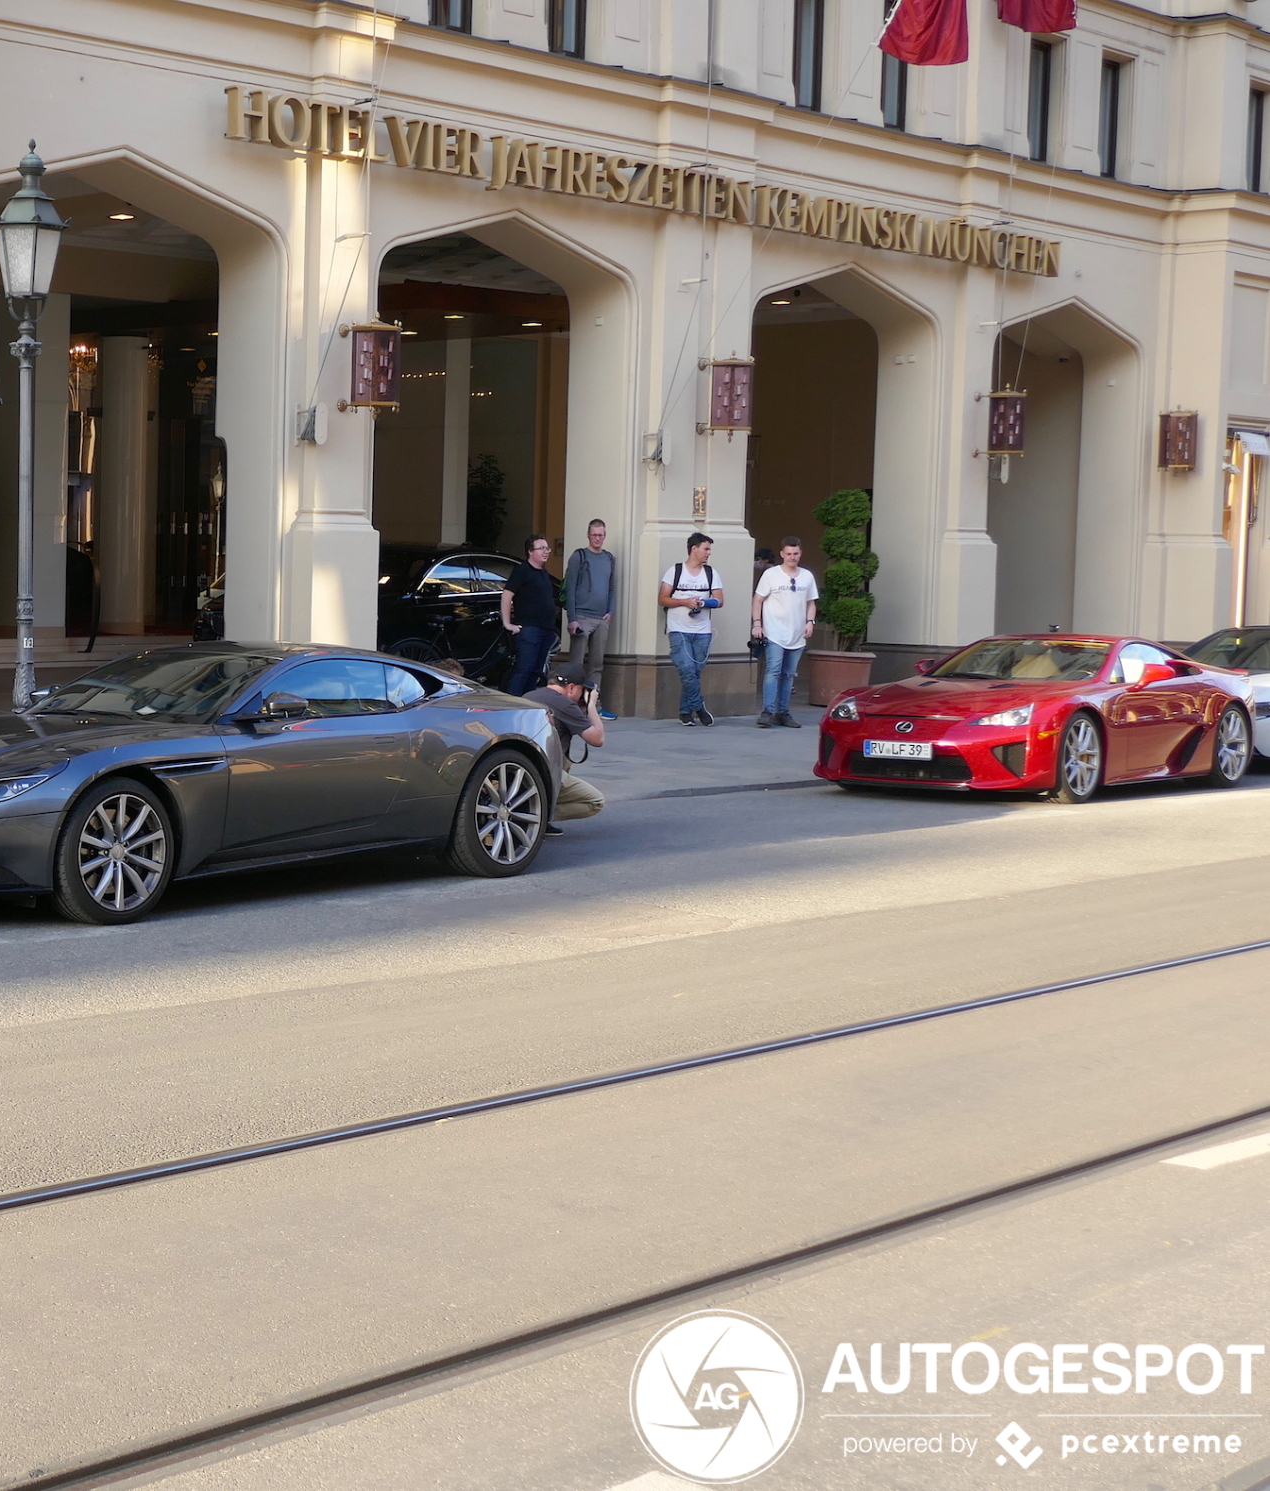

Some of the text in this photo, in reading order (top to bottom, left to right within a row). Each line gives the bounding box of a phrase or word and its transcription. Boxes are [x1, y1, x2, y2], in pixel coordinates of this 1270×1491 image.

[224, 85, 1062, 277] HOTEL VIER JAHRESZEITEN KEMPINSKI MÜNCHEN
[871, 742, 923, 756] RV LF 39
